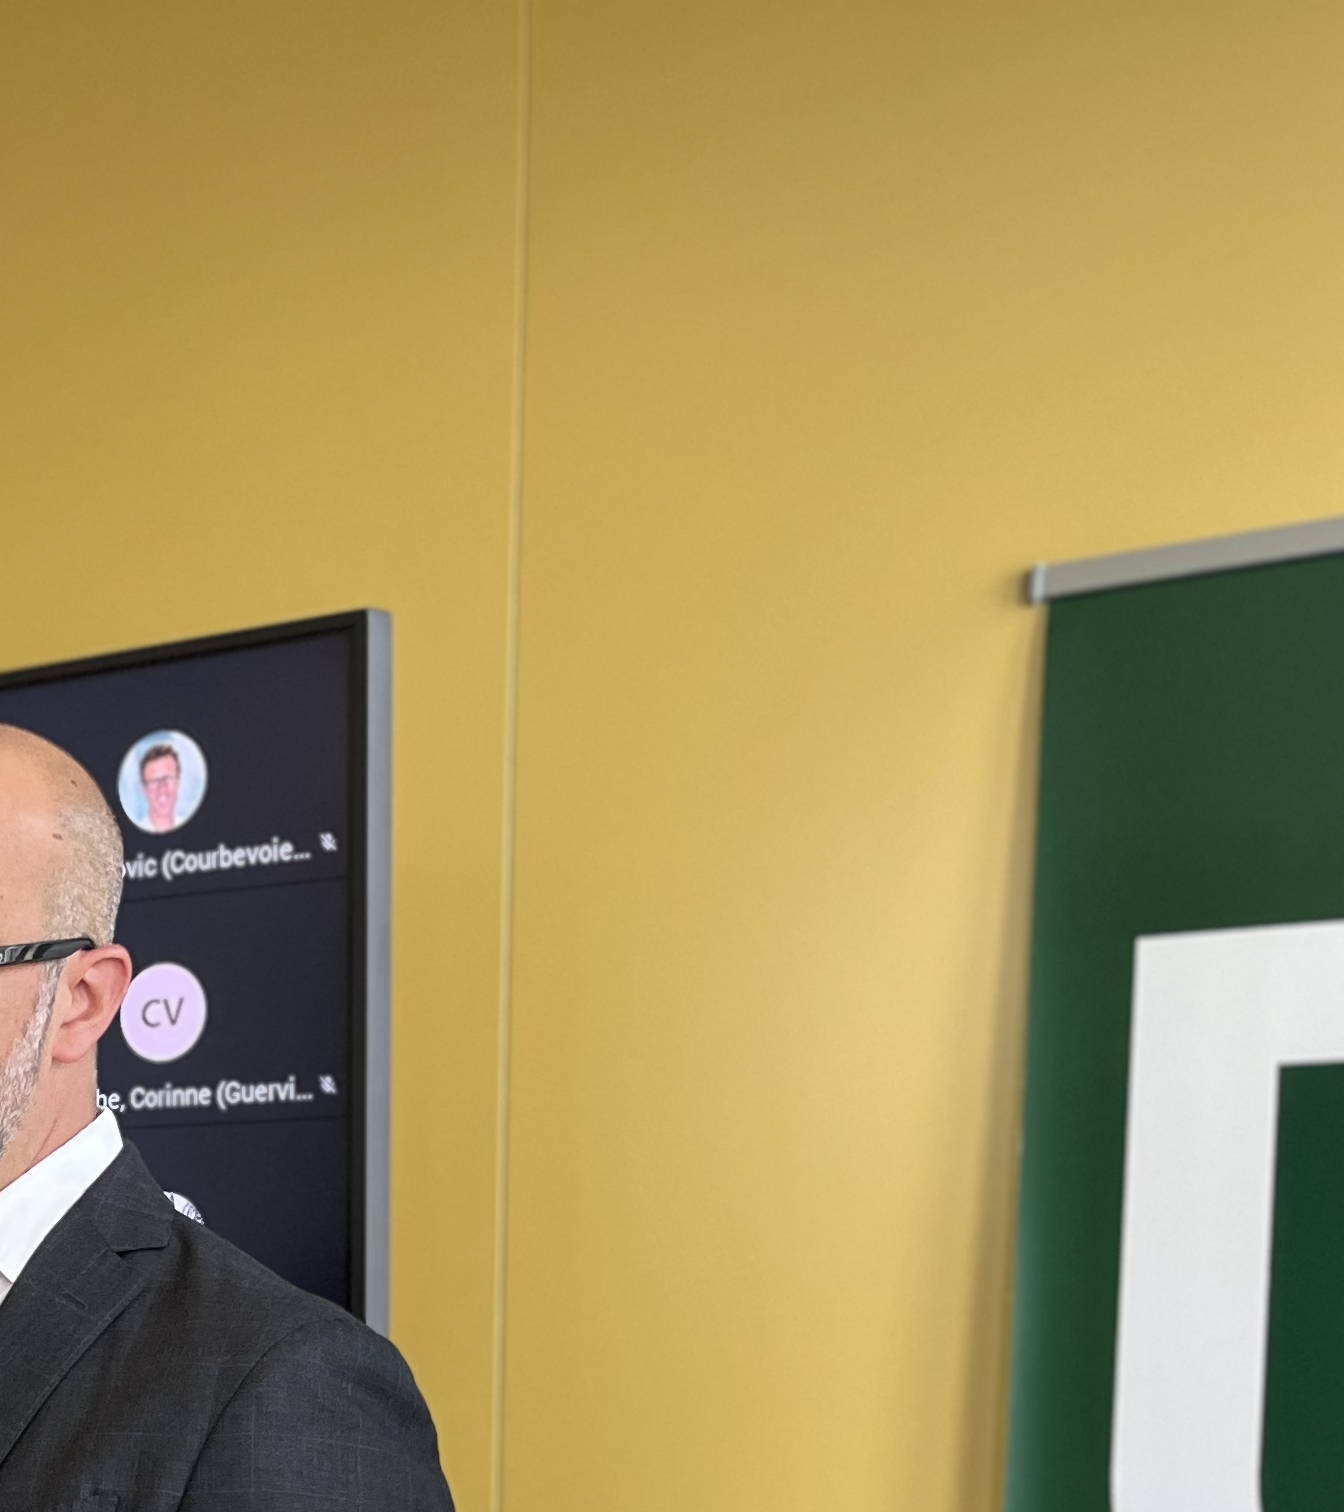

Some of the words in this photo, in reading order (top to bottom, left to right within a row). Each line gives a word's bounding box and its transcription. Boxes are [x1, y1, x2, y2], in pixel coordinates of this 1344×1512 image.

[161, 834, 311, 881] (Courbevoie...
[141, 996, 185, 1028] CV
[129, 1083, 212, 1110] Corinne
